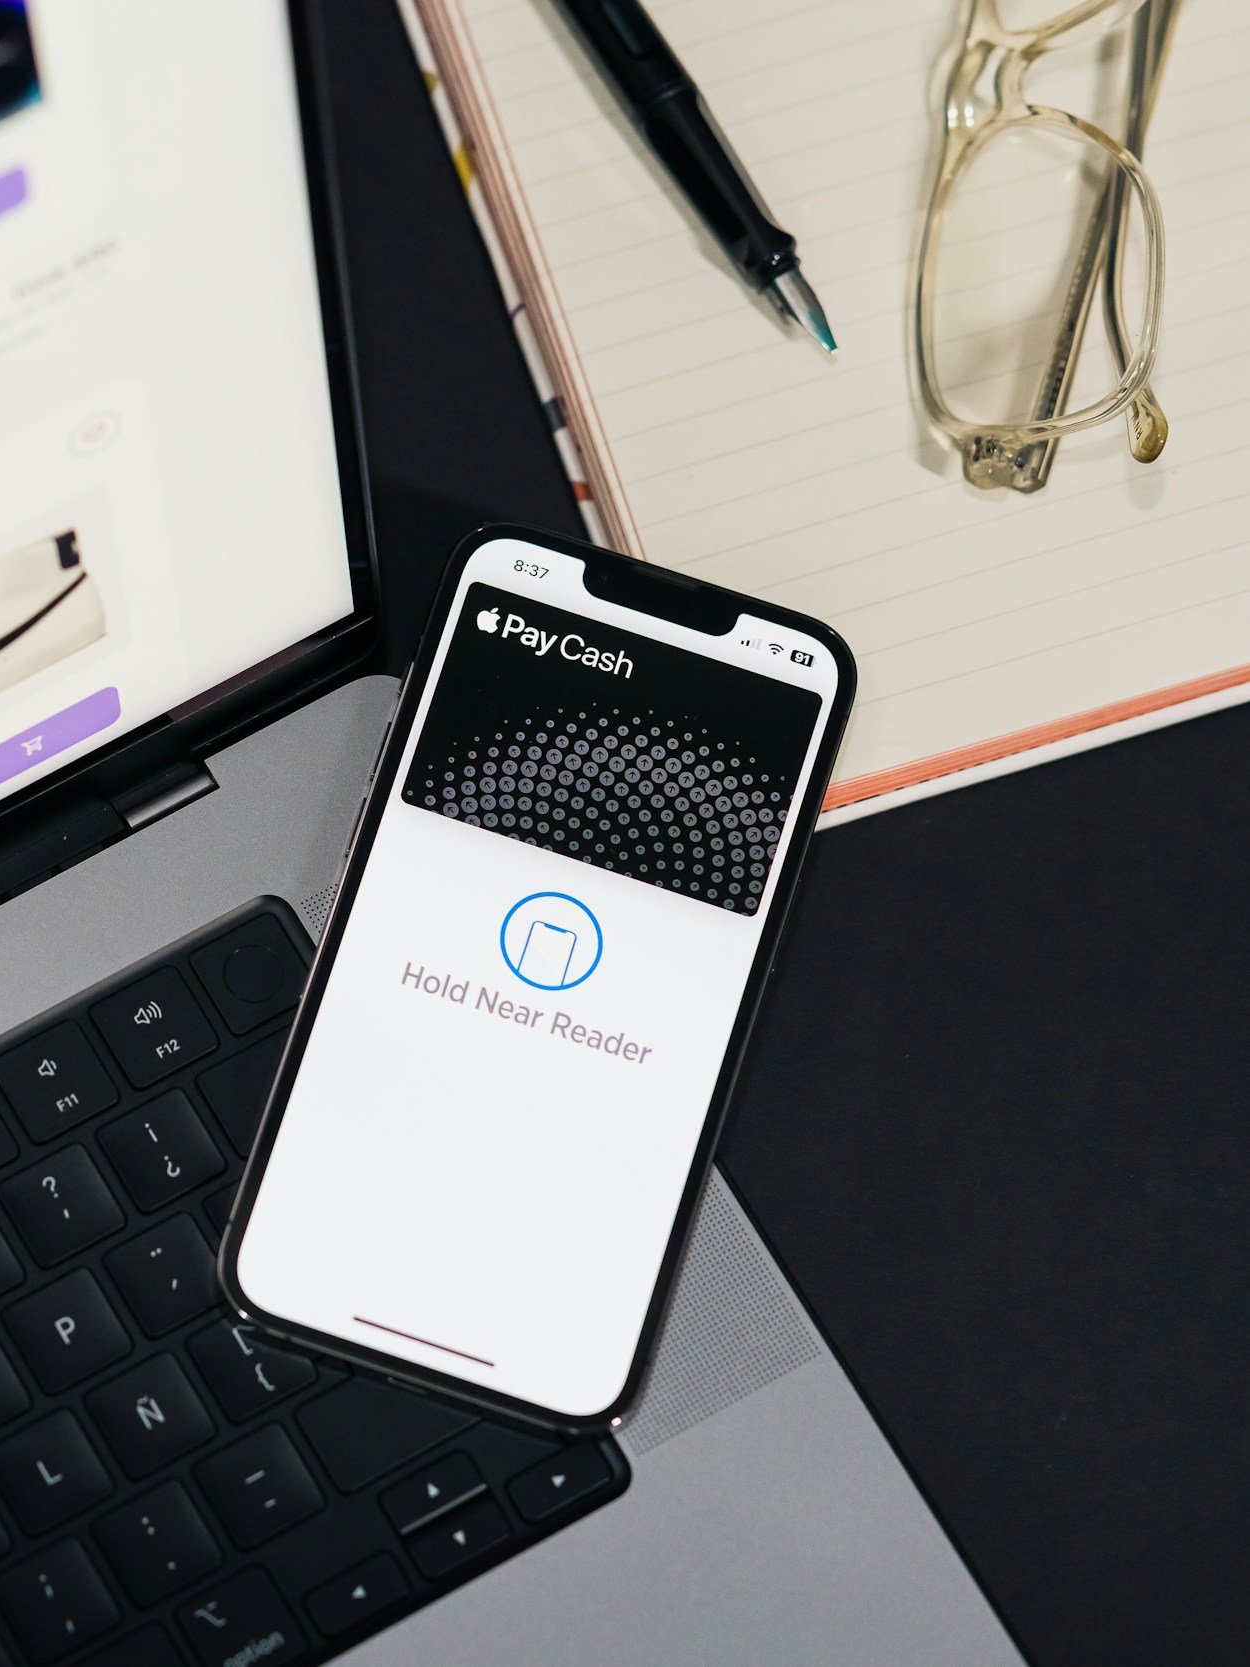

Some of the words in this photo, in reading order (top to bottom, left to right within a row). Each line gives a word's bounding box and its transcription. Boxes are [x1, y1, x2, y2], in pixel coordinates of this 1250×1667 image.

[513, 559, 549, 579] 8:37
[501, 613, 558, 656] Pay
[560, 634, 634, 679] Cash
[794, 652, 811, 666] 91
[401, 961, 470, 1004] Hold
[475, 987, 544, 1028] Near
[550, 1011, 652, 1064] Reader
[155, 1038, 181, 1059] F12
[55, 1093, 79, 1113] F11
[41, 1176, 59, 1199] ?
[54, 1316, 76, 1345] P
[136, 1396, 165, 1429] Ñ
[36, 1460, 63, 1486] L
